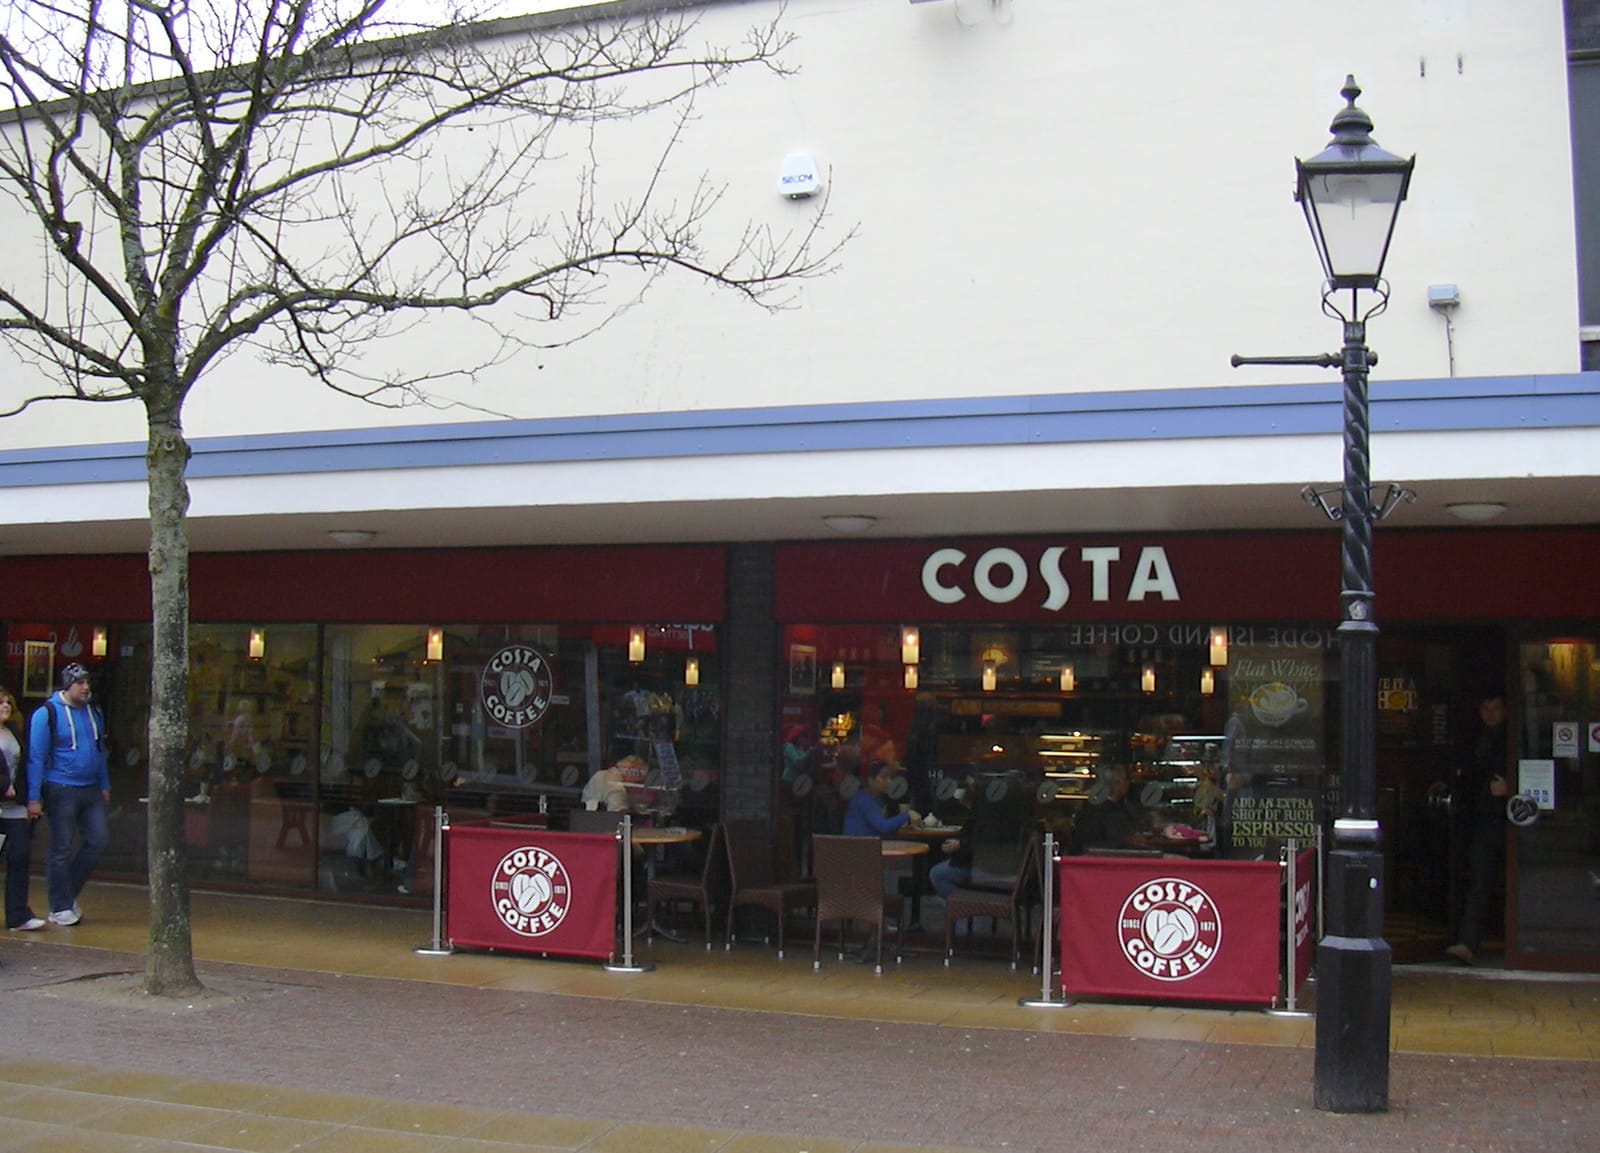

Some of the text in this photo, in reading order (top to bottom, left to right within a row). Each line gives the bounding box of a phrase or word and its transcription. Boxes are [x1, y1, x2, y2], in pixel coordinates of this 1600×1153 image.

[921, 545, 1182, 613] COSTA
[491, 649, 542, 674] COSTA
[1233, 658, 1317, 677] Flat White
[486, 694, 547, 725] COFFEE
[1377, 690, 1419, 710] HOT.
[1232, 798, 1314, 809] ADD AN EXTRA
[1232, 809, 1315, 821] SHOT OF RICH
[1232, 821, 1315, 837] ESPRESSO
[1232, 837, 1245, 848] TO
[502, 851, 558, 879] COSTA
[1132, 881, 1205, 914] COSTA
[497, 898, 564, 933] COFFEE
[1126, 938, 1213, 977] COFFEE
